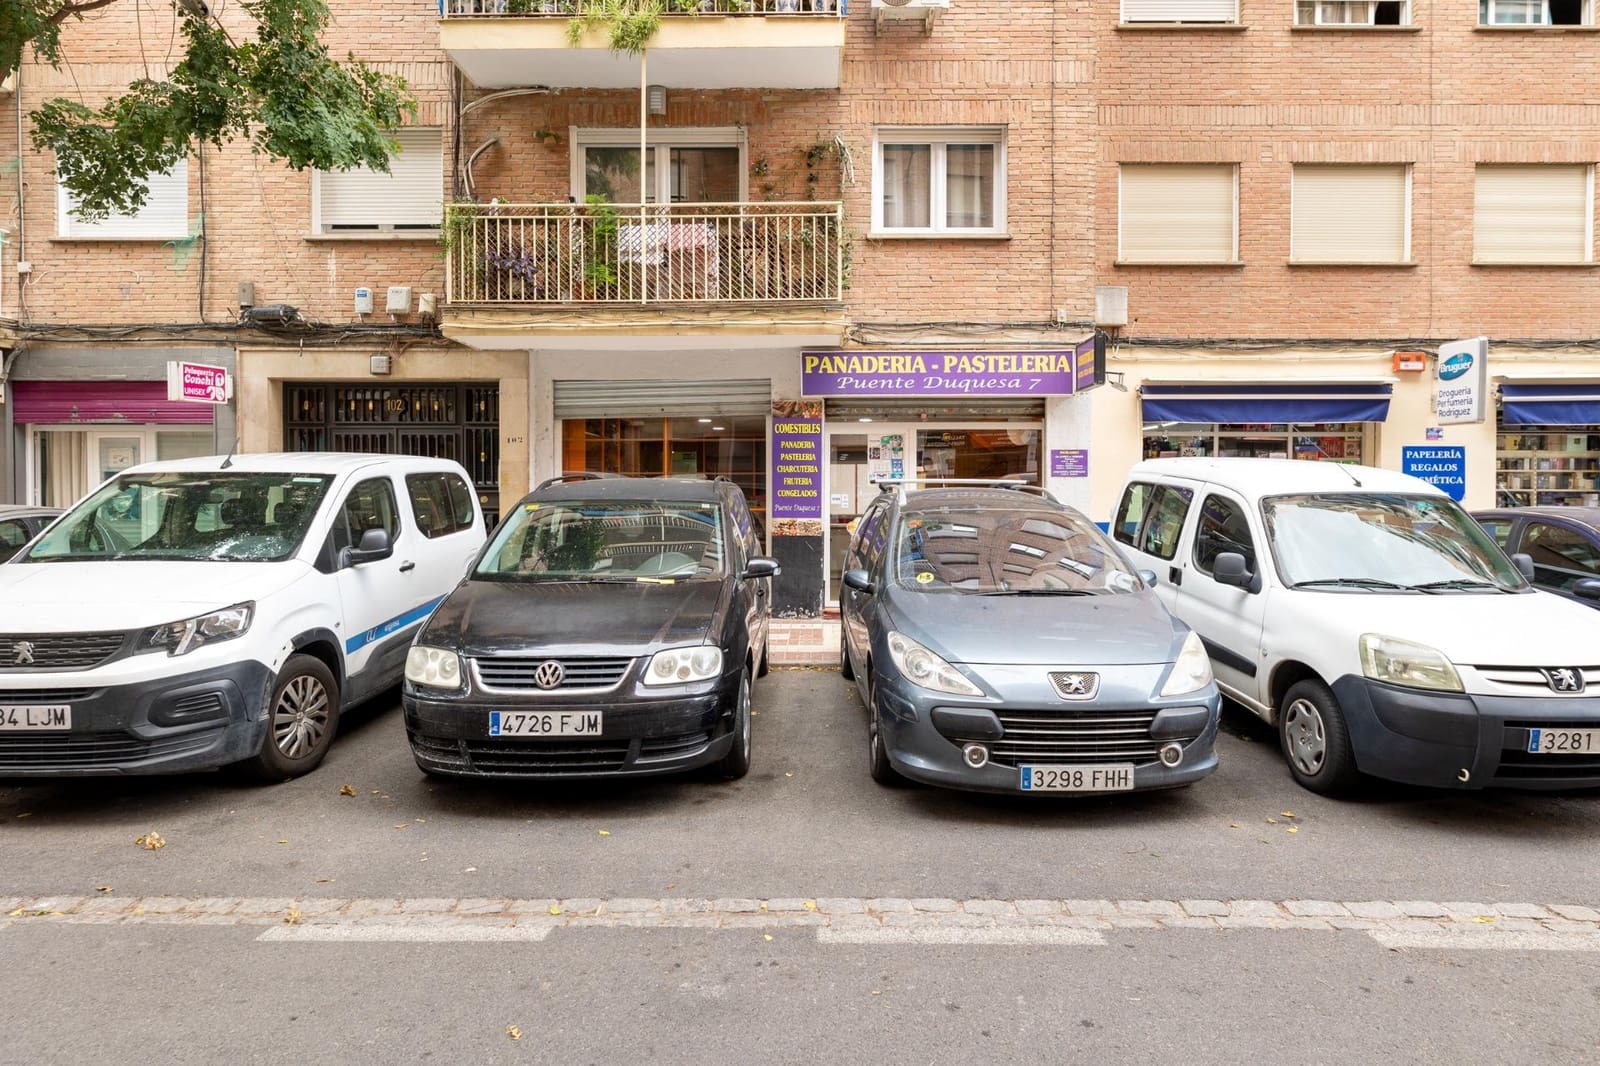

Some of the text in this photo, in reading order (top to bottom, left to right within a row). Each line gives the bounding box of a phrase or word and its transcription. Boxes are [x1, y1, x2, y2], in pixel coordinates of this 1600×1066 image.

[805, 355, 927, 374] PANADERIA
[943, 355, 1071, 373] PASTELERIA
[184, 373, 214, 386] Conchi
[836, 376, 1042, 393] Puente Duquesa 7
[184, 387, 206, 396] UNISEX
[387, 399, 402, 411] 102
[774, 423, 821, 434] COMESTIBLES
[780, 440, 815, 449] PANADERIA
[780, 453, 816, 461] PASTELERIA
[1406, 448, 1462, 459] PAPELERÍA
[776, 465, 818, 473] CHARCUTERIA
[1410, 463, 1458, 472] REGALOS
[783, 477, 812, 486] FRUTERIA
[1418, 475, 1464, 485] MÉTICA
[777, 489, 818, 498] CONGELADOS
[26, 708, 65, 726] LJM
[502, 715, 598, 733] 4726 FJM
[1544, 732, 1592, 751] 3281
[1034, 769, 1128, 788] 3298 FHH
